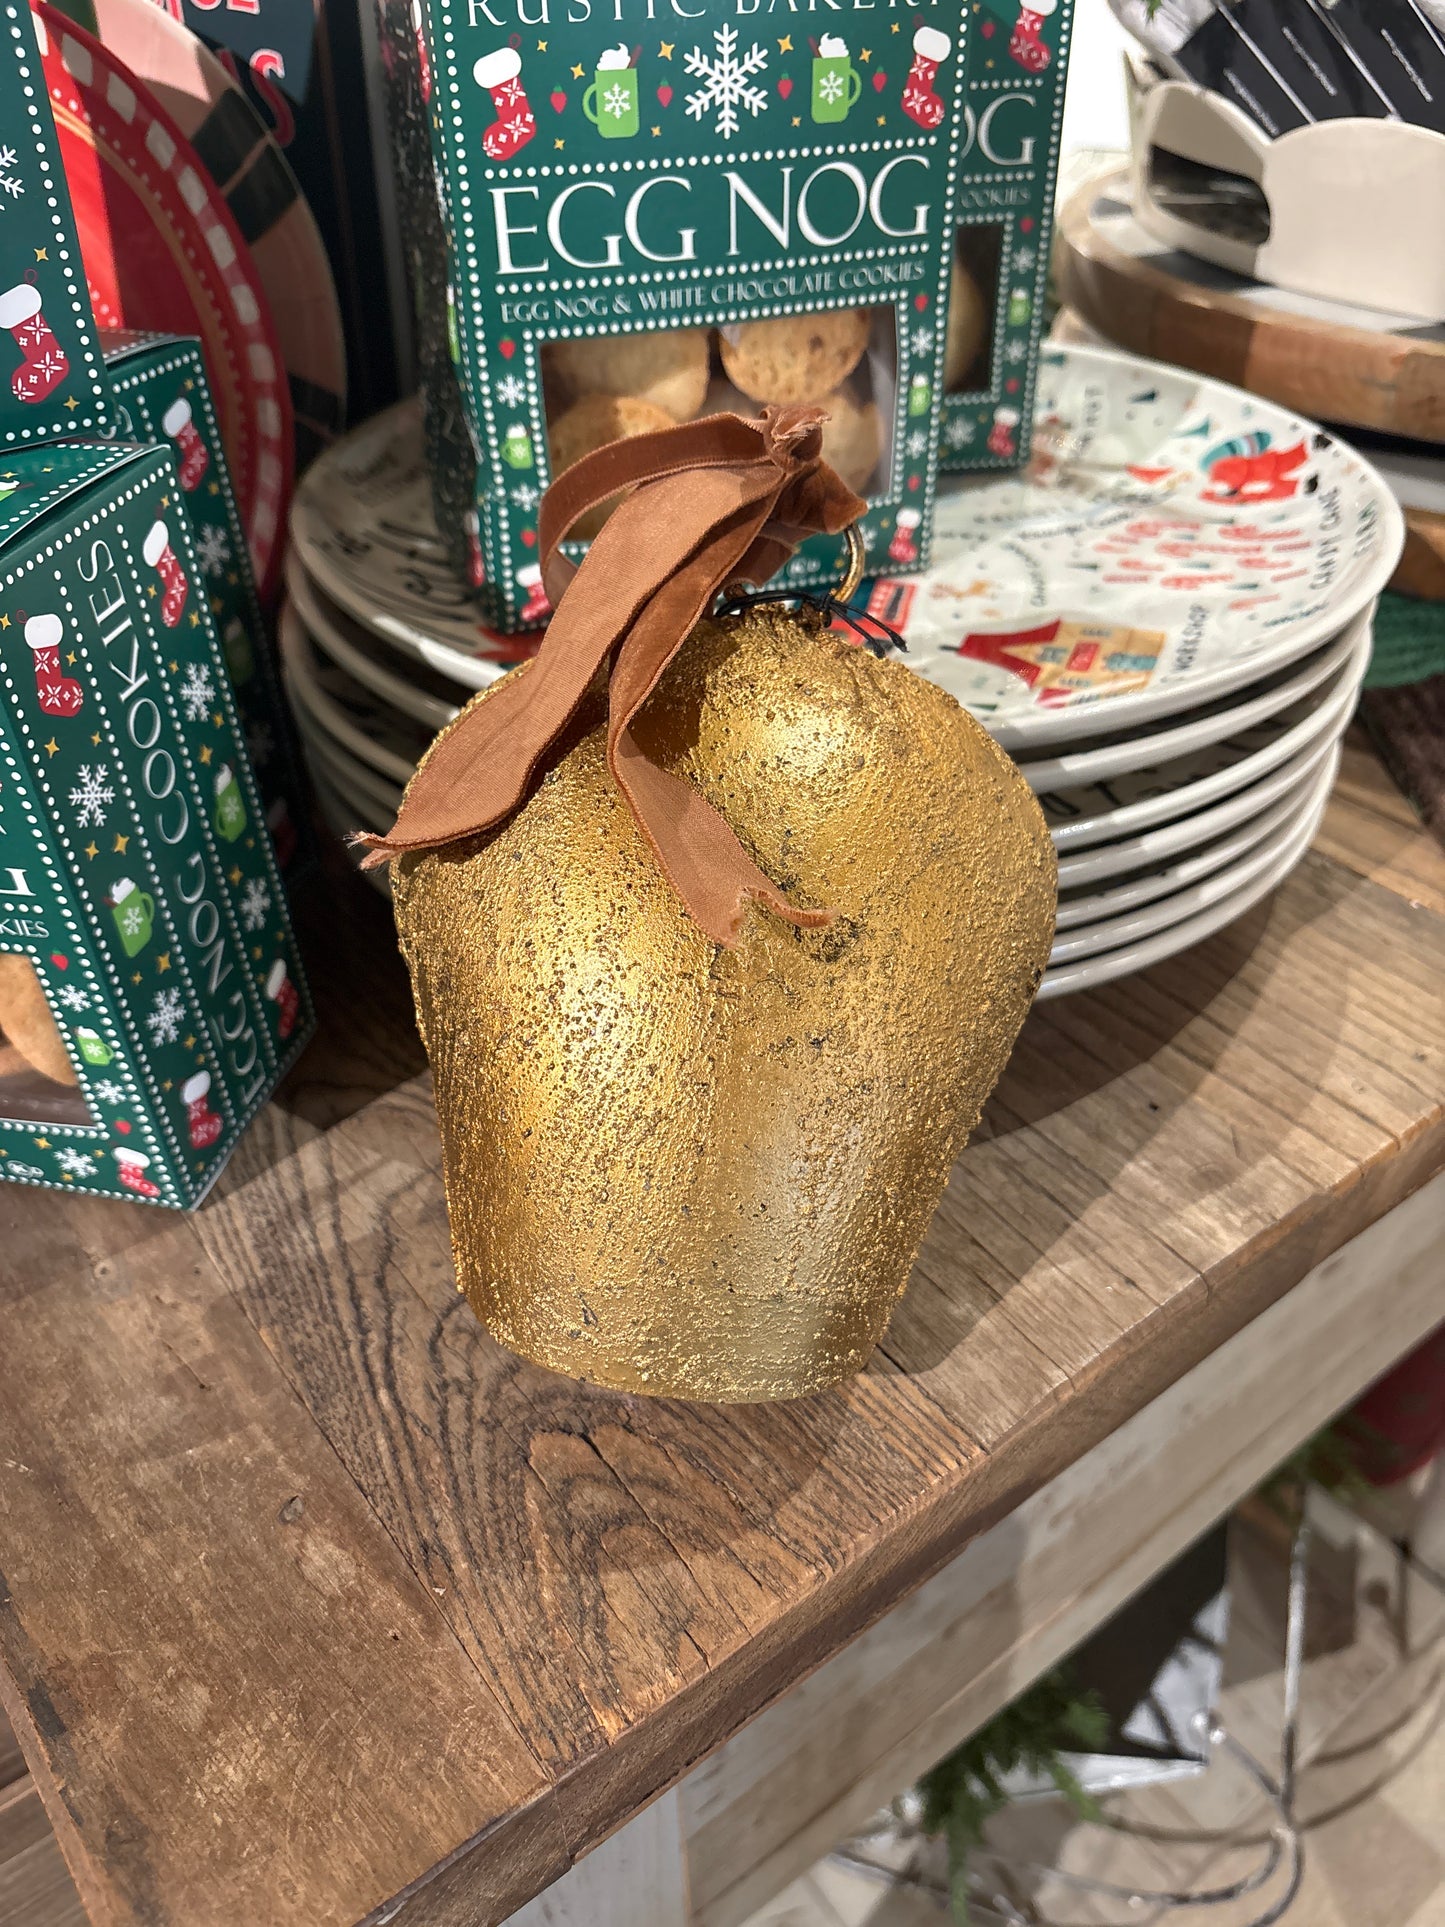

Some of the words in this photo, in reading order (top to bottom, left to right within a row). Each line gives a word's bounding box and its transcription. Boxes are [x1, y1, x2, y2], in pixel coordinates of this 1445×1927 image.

[487, 176, 698, 275] EGG
[721, 154, 932, 256] NOG
[501, 299, 550, 324] EGG
[554, 295, 609, 320] NOG
[612, 293, 633, 315] &
[638, 286, 708, 311] WHITE
[711, 271, 836, 305] CHOCOLATE
[839, 260, 926, 290] COOKIES
[77, 539, 189, 845] COOKIES
[1170, 603, 1210, 673] WORKSHOP
[0, 918, 50, 939] KIES
[173, 851, 234, 995] NOG
[218, 990, 267, 1104] EGG
